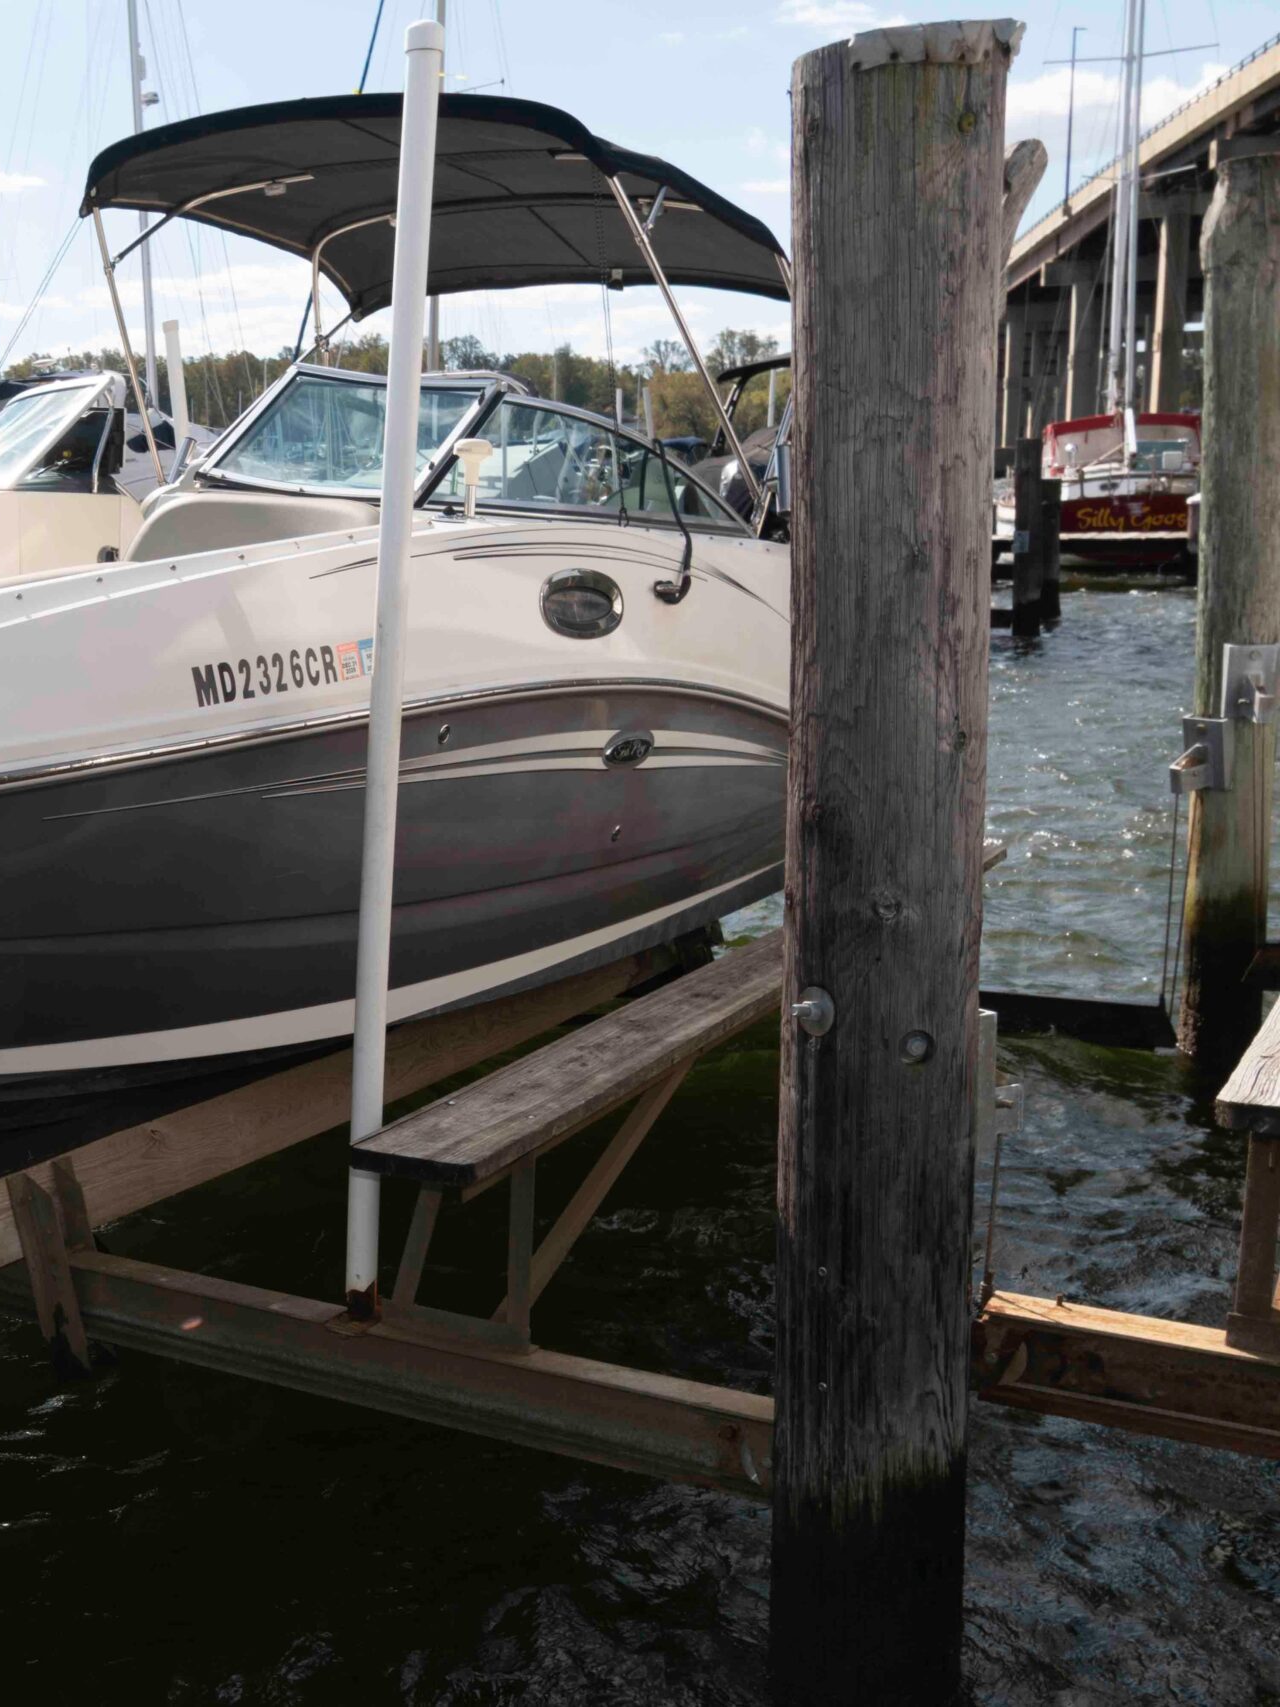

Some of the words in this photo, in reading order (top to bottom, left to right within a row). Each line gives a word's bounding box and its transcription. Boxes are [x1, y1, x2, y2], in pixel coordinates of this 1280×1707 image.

[1077, 507, 1124, 532] Silly
[1131, 506, 1187, 530] Goos
[191, 645, 338, 708] MD2326CR
